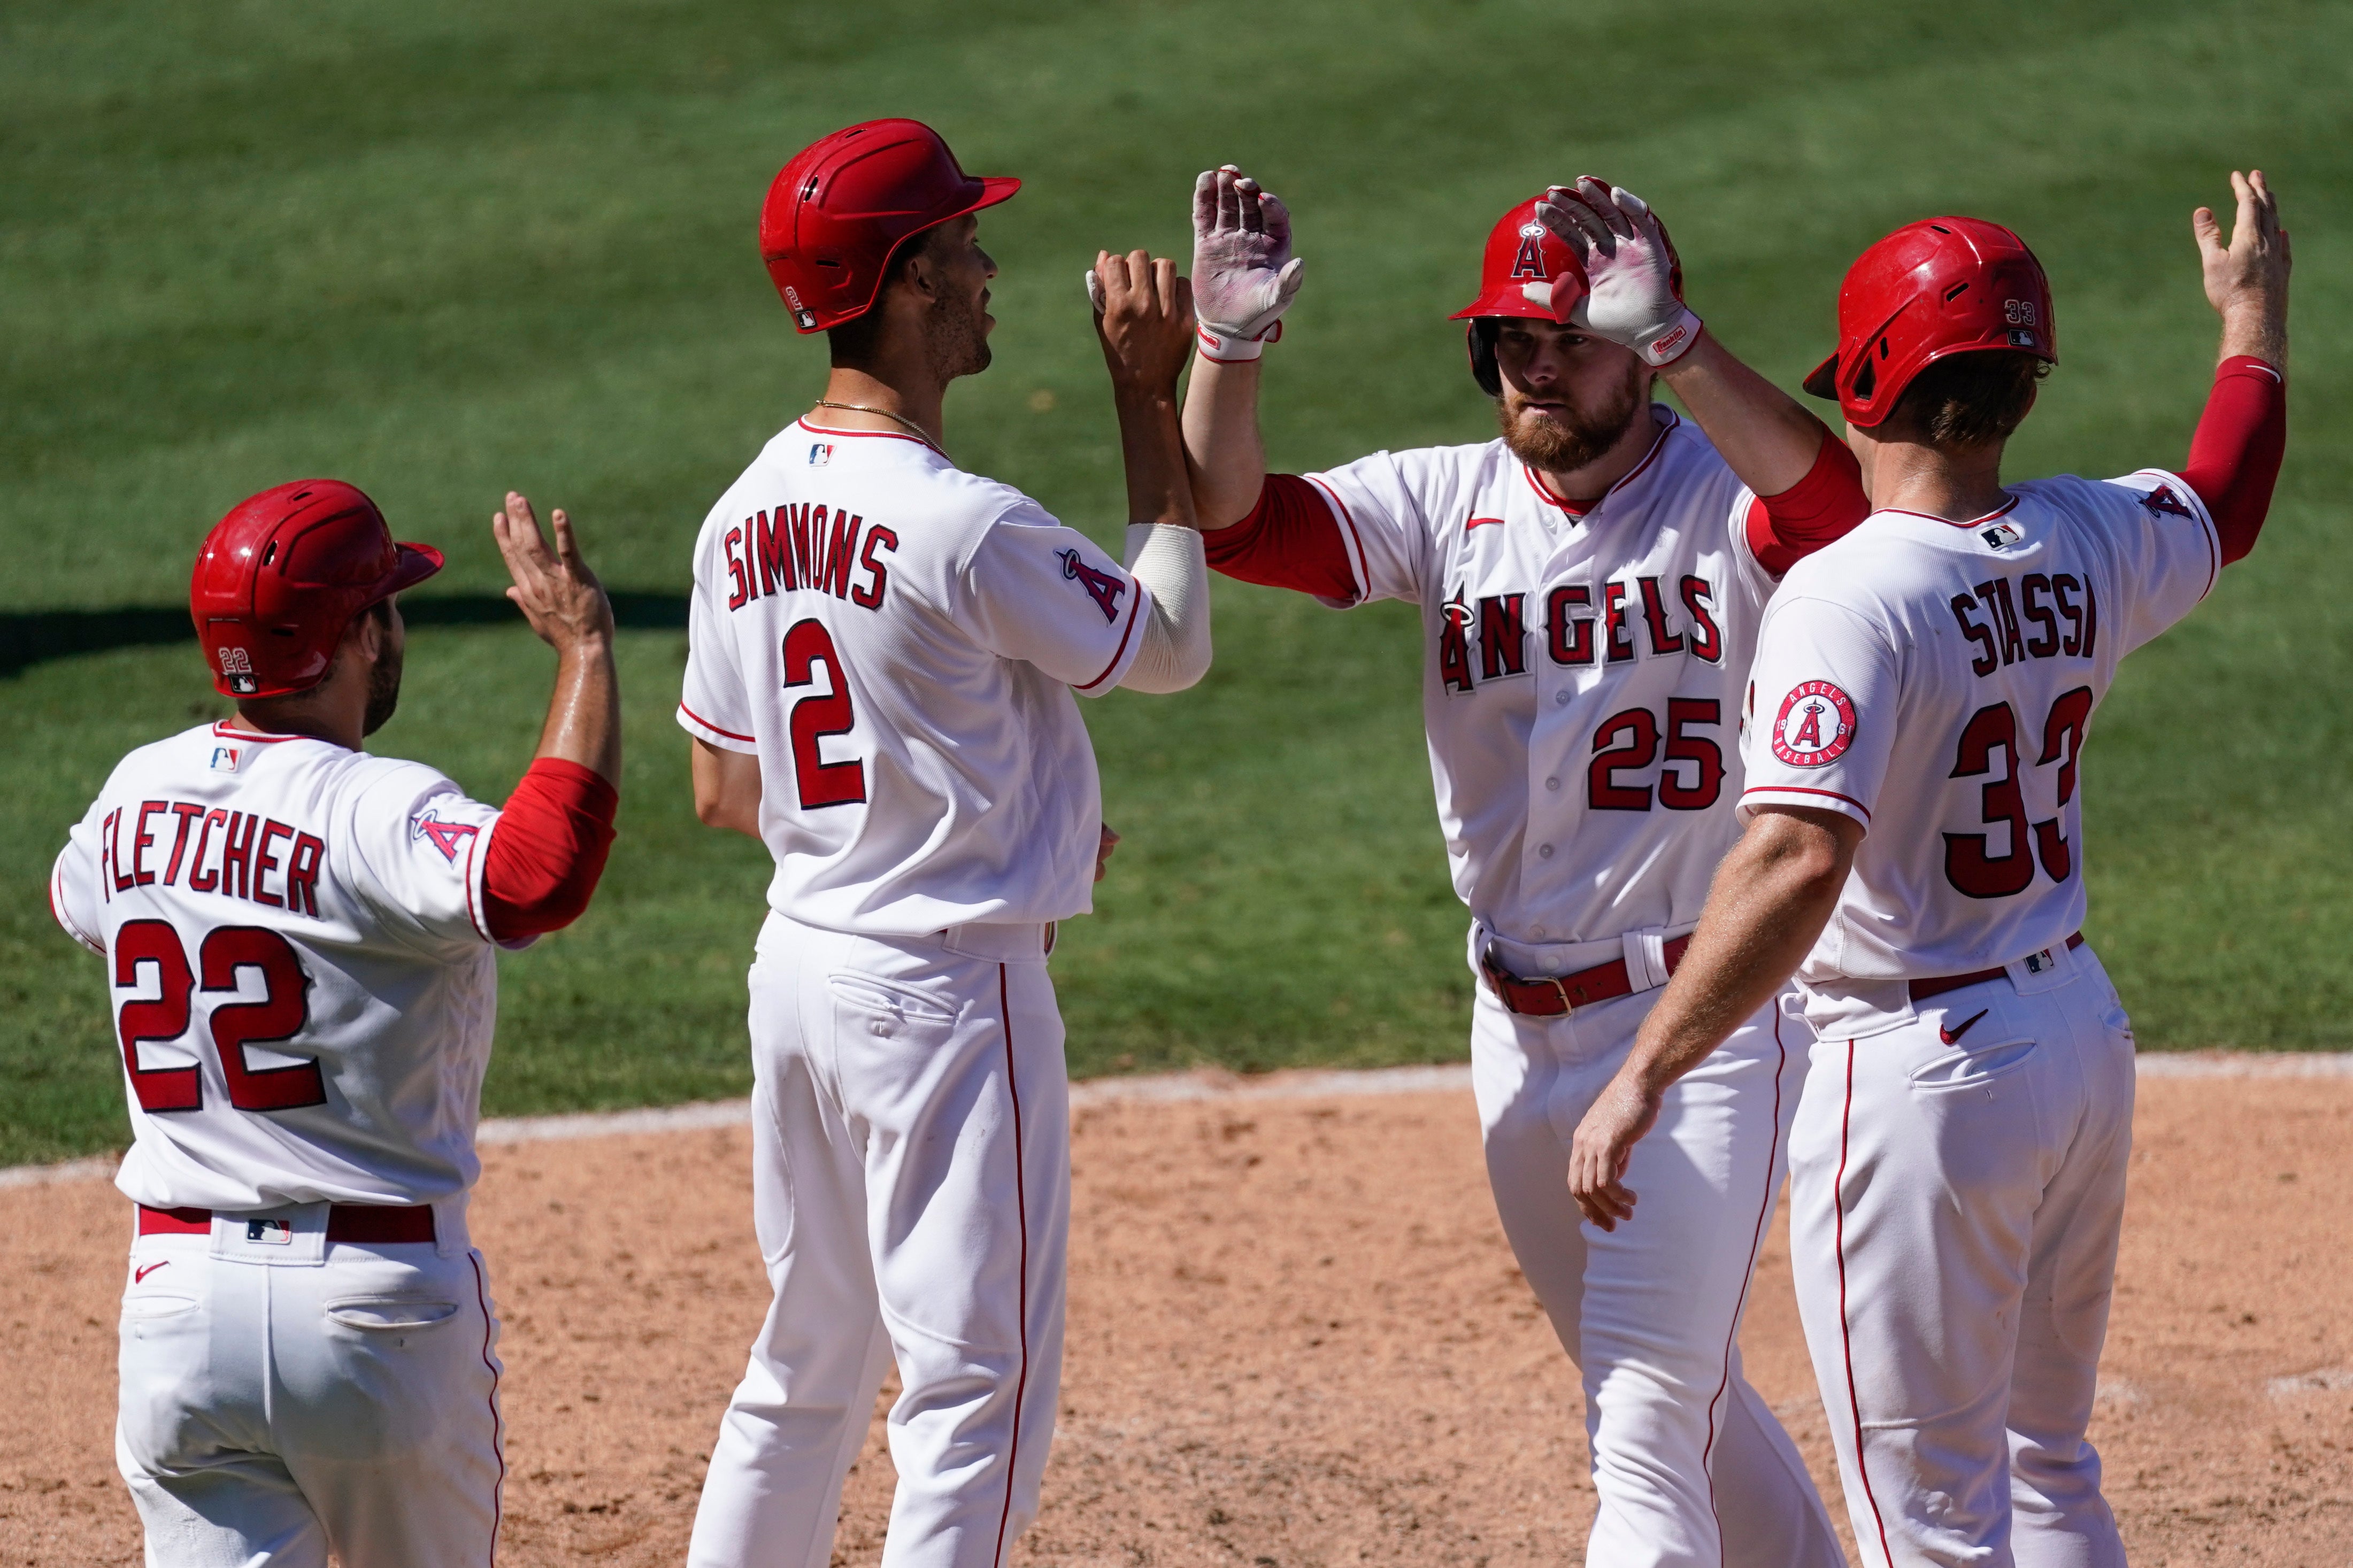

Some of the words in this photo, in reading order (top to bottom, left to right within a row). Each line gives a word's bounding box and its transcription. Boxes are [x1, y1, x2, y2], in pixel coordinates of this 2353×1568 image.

[1510, 219, 1548, 278] A
[786, 286, 803, 310] 2
[2004, 299, 2035, 326] 33
[1656, 329, 1683, 353] Franklin
[724, 503, 898, 611] SIMMONS
[1056, 549, 1126, 625] A
[1440, 575, 1725, 695] ANGELS
[1951, 573, 2096, 677] STASSI
[218, 647, 252, 673] 22
[783, 617, 866, 810] 2
[1777, 719, 1787, 731] 19
[1789, 682, 1847, 706] ANGELS
[1792, 697, 1825, 747] A
[1588, 697, 1726, 812] 25
[1774, 737, 1844, 764] BASEBALL
[1942, 685, 2094, 899] 33
[102, 800, 325, 918] FLETCHER
[115, 918, 327, 1113] 22
